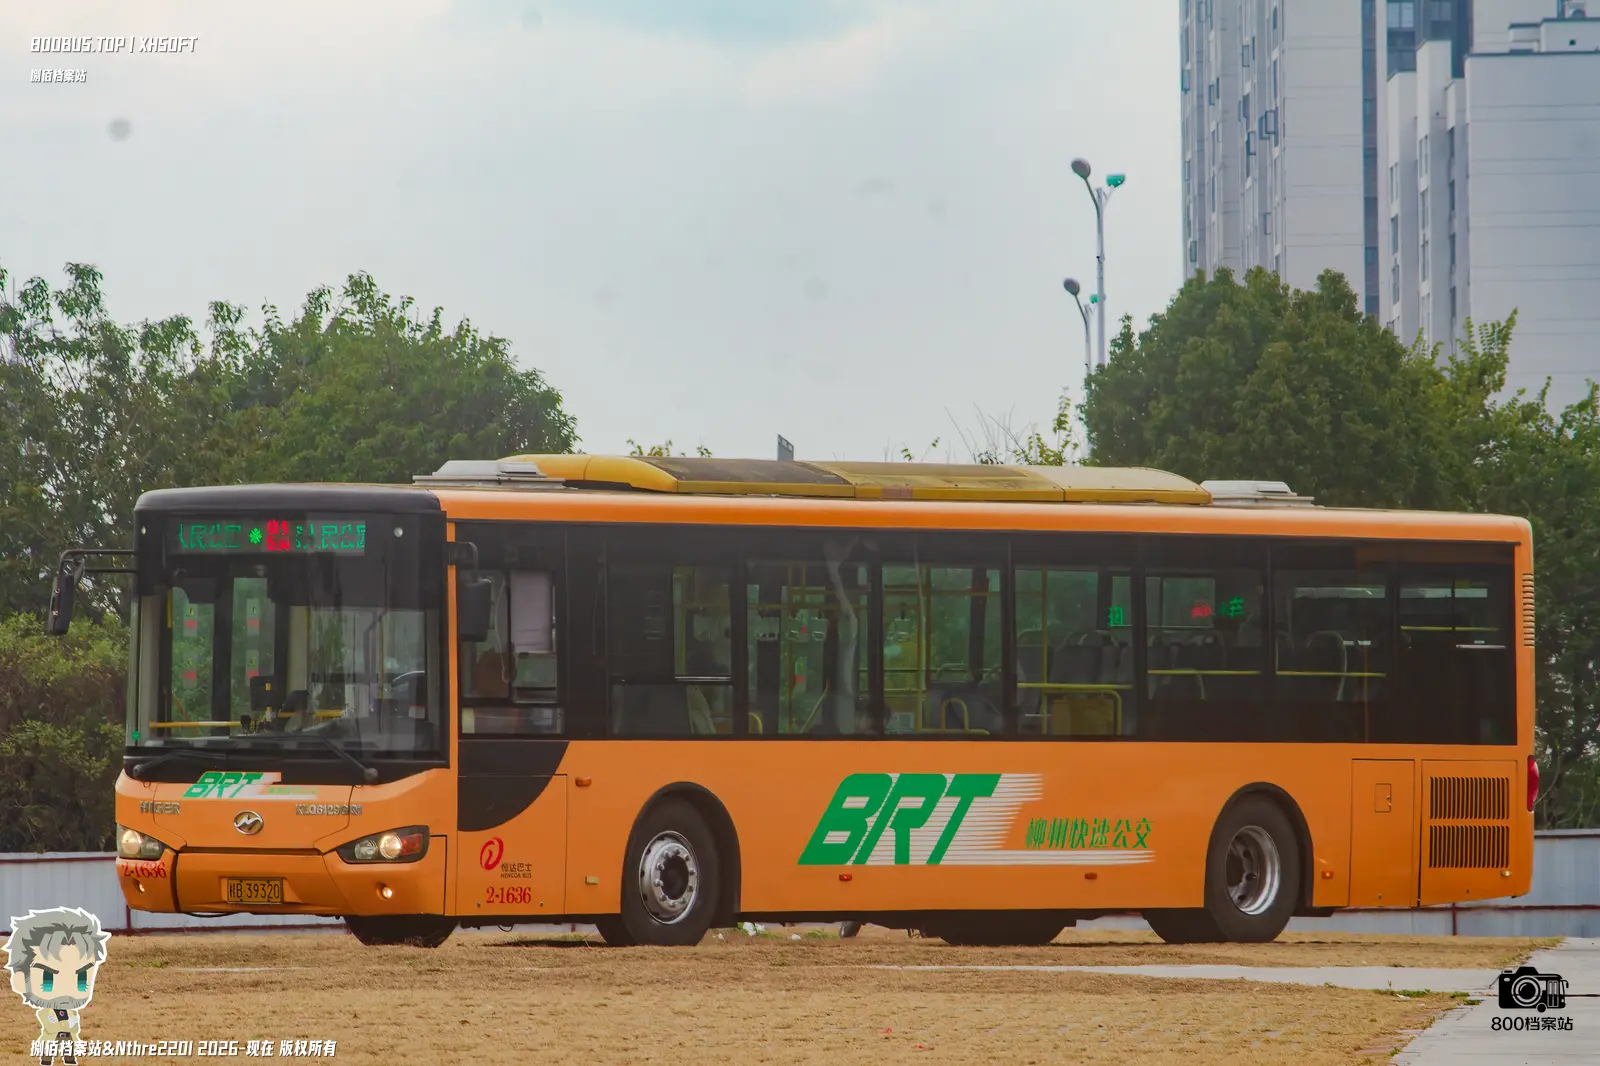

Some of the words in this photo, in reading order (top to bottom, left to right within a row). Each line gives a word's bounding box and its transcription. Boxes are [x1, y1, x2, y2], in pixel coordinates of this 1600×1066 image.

[182, 771, 264, 799] BRT
[139, 801, 181, 815] HIGER
[797, 773, 1003, 866] BRT
[1025, 817, 1155, 850] 柳州快速公交
[121, 861, 167, 879] 2-1636
[501, 862, 532, 872] 恒达巴士
[486, 886, 532, 904] 2-1636
